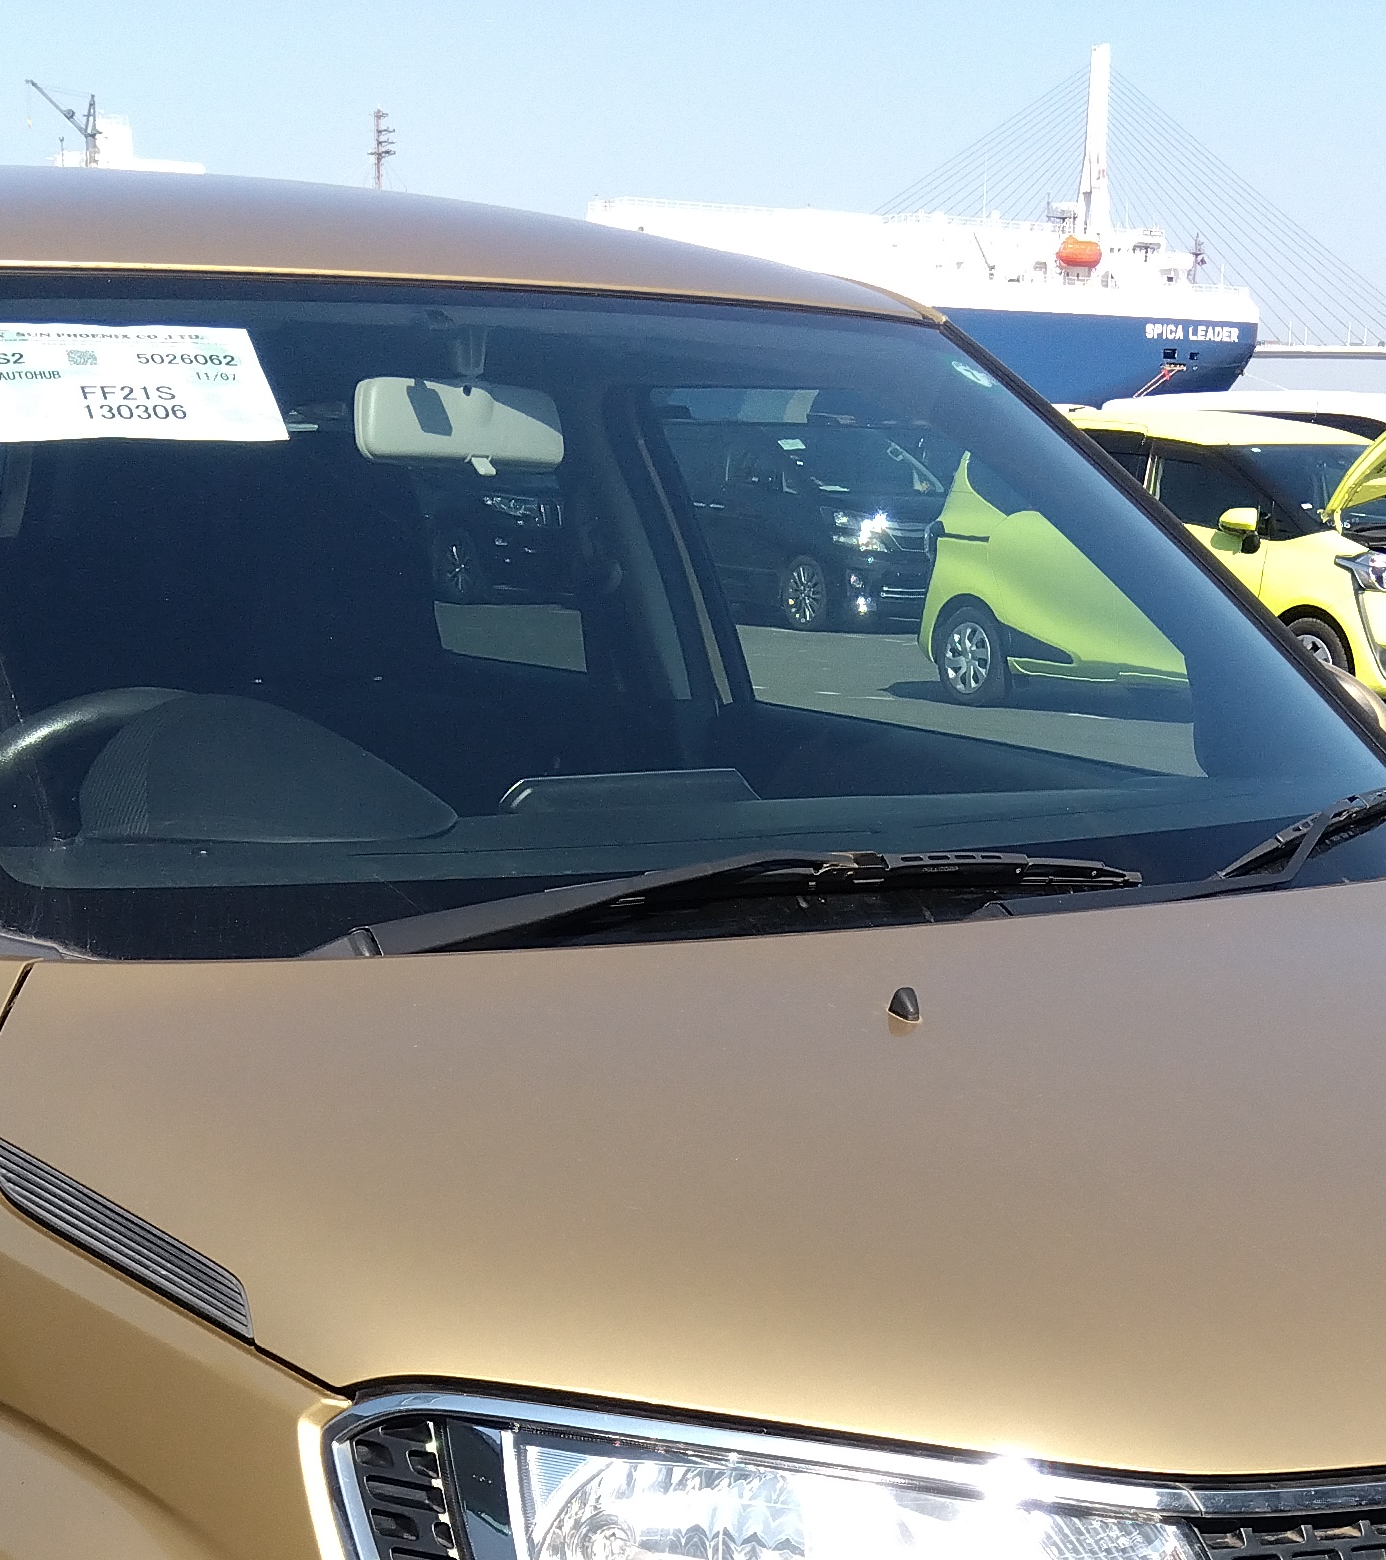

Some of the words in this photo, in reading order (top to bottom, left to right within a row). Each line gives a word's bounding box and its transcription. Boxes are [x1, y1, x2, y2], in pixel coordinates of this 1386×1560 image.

[1145, 323, 1184, 339] SPICA
[1188, 325, 1239, 342] LEADER
[136, 353, 238, 367] 5026062
[80, 385, 176, 400] FF21S
[84, 404, 187, 420] 130306
